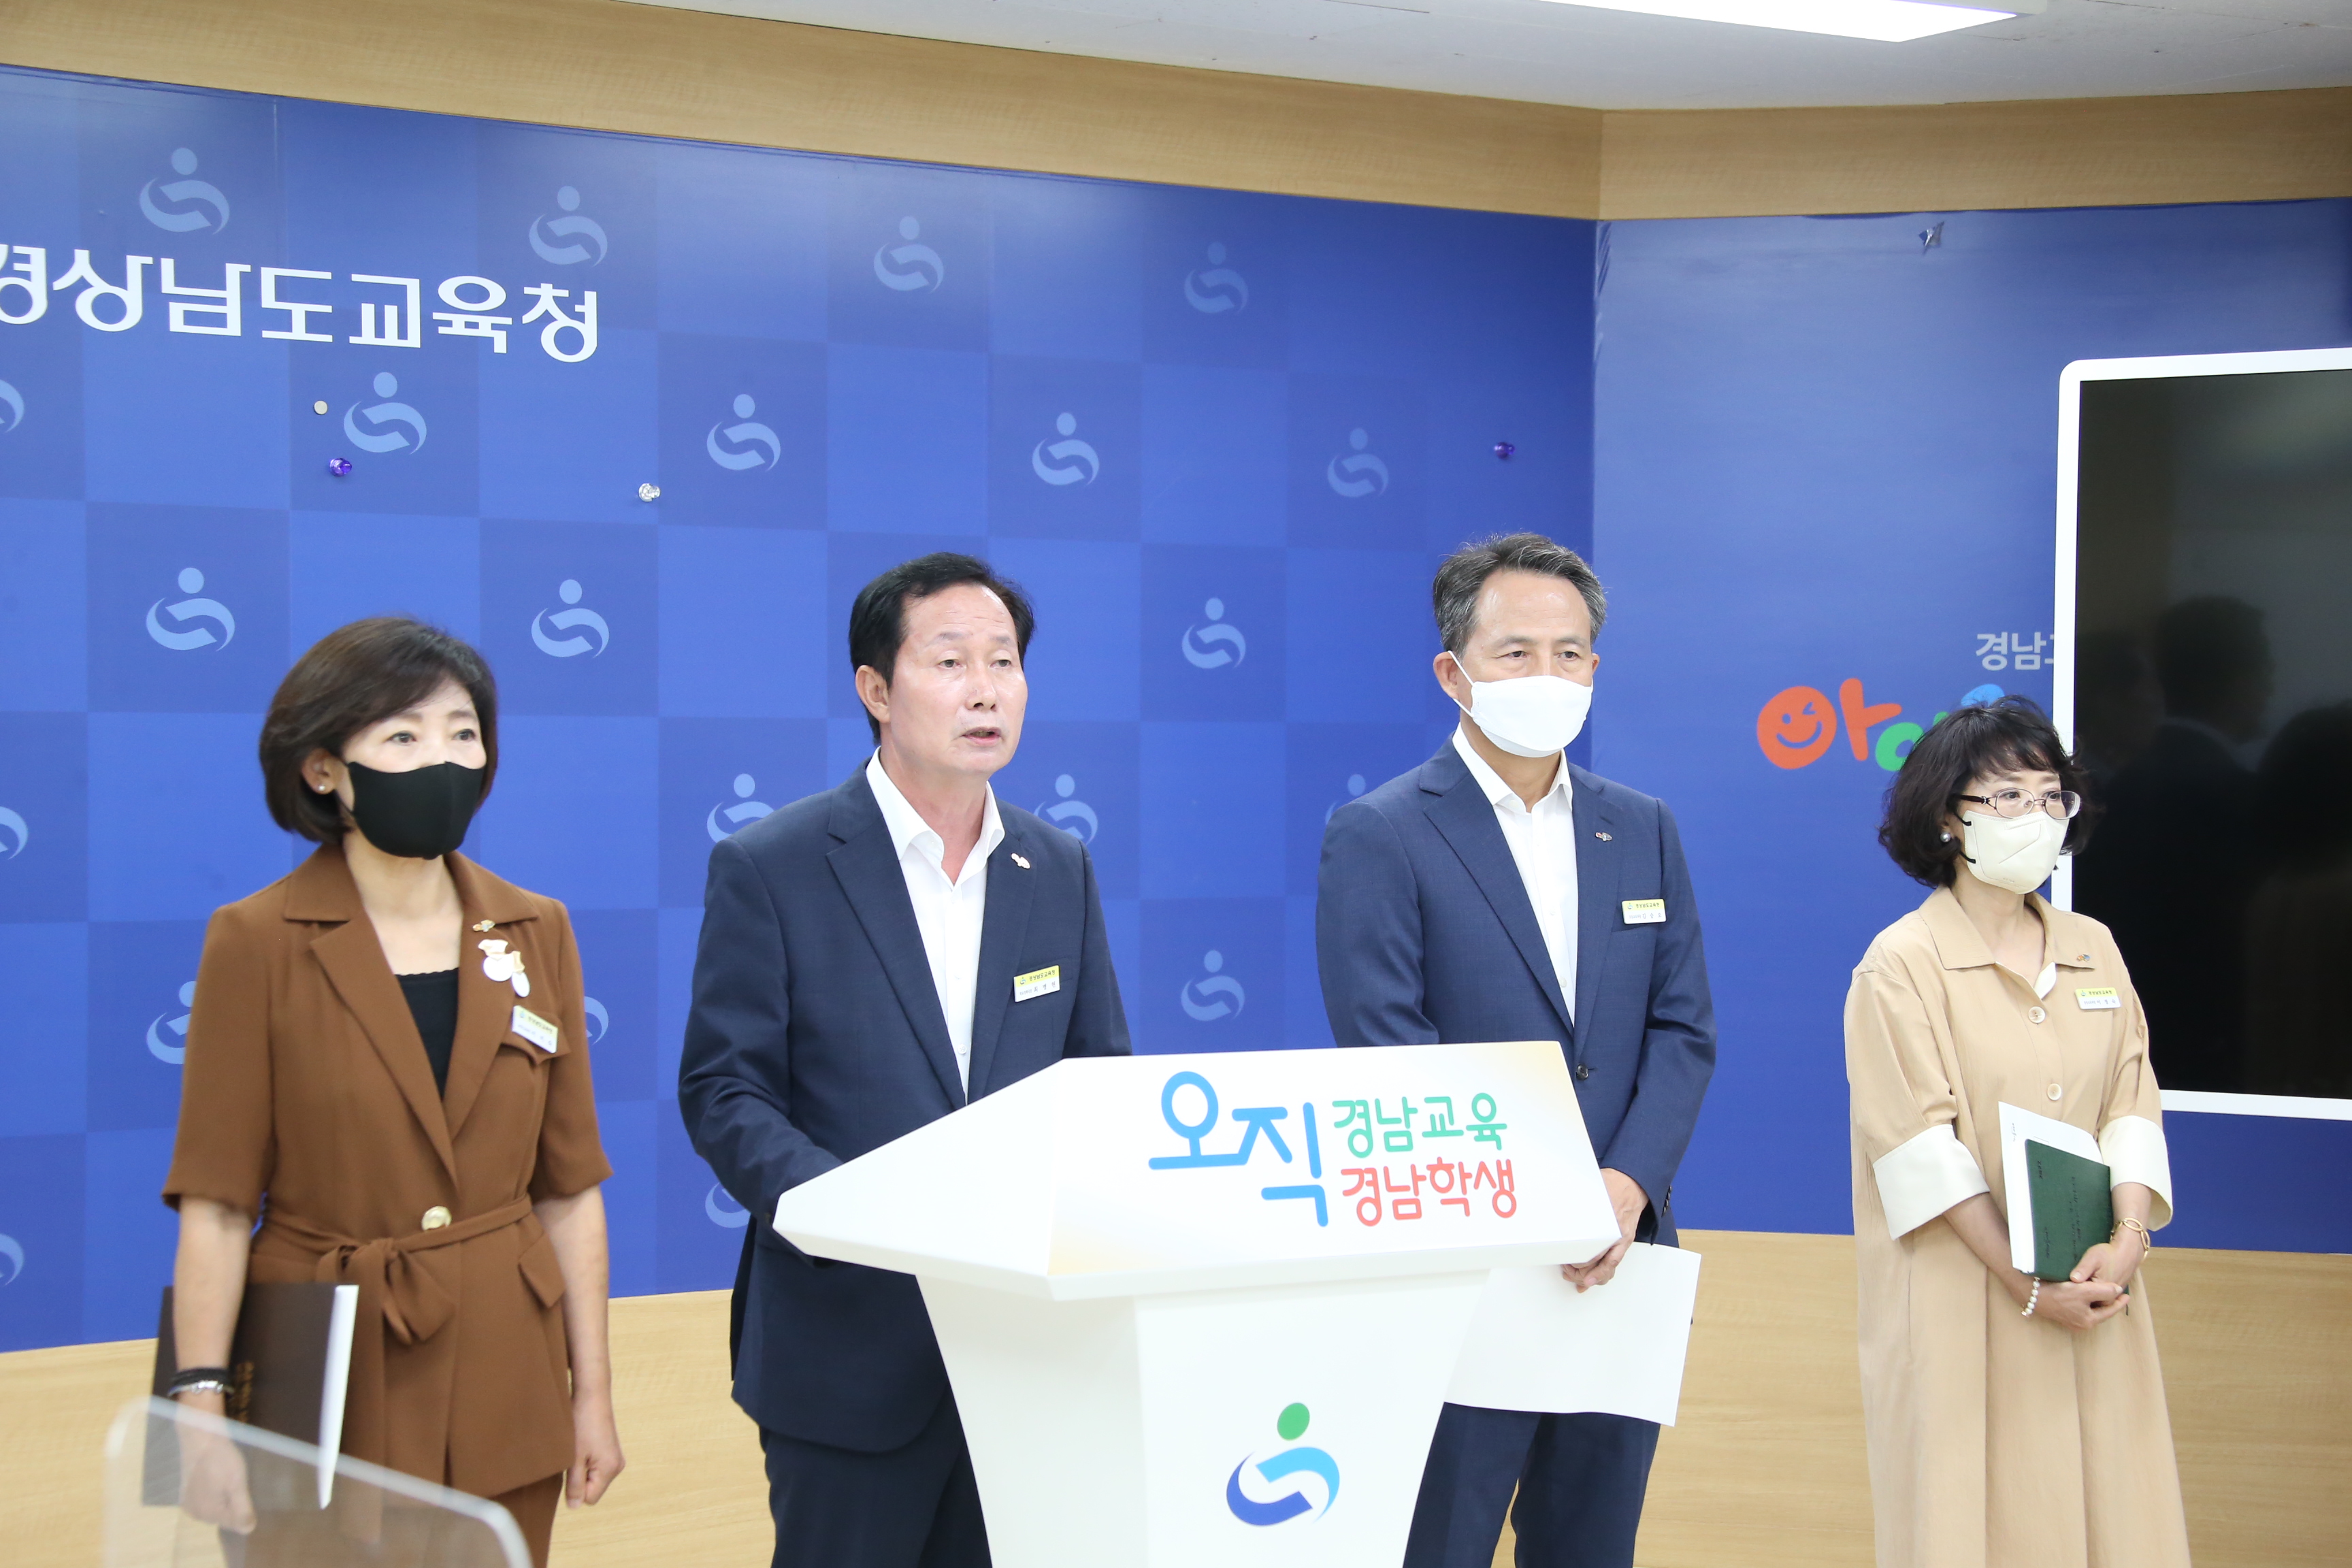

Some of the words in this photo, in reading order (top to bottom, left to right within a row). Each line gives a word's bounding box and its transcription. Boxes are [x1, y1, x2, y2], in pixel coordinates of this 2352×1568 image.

[0, 244, 598, 363] 경상남도교육청
[1976, 632, 2054, 671] 경남
[1148, 1071, 1329, 1228] 오직
[1332, 1092, 1508, 1159] 경남교육
[1341, 1156, 1518, 1227] 경남학생
